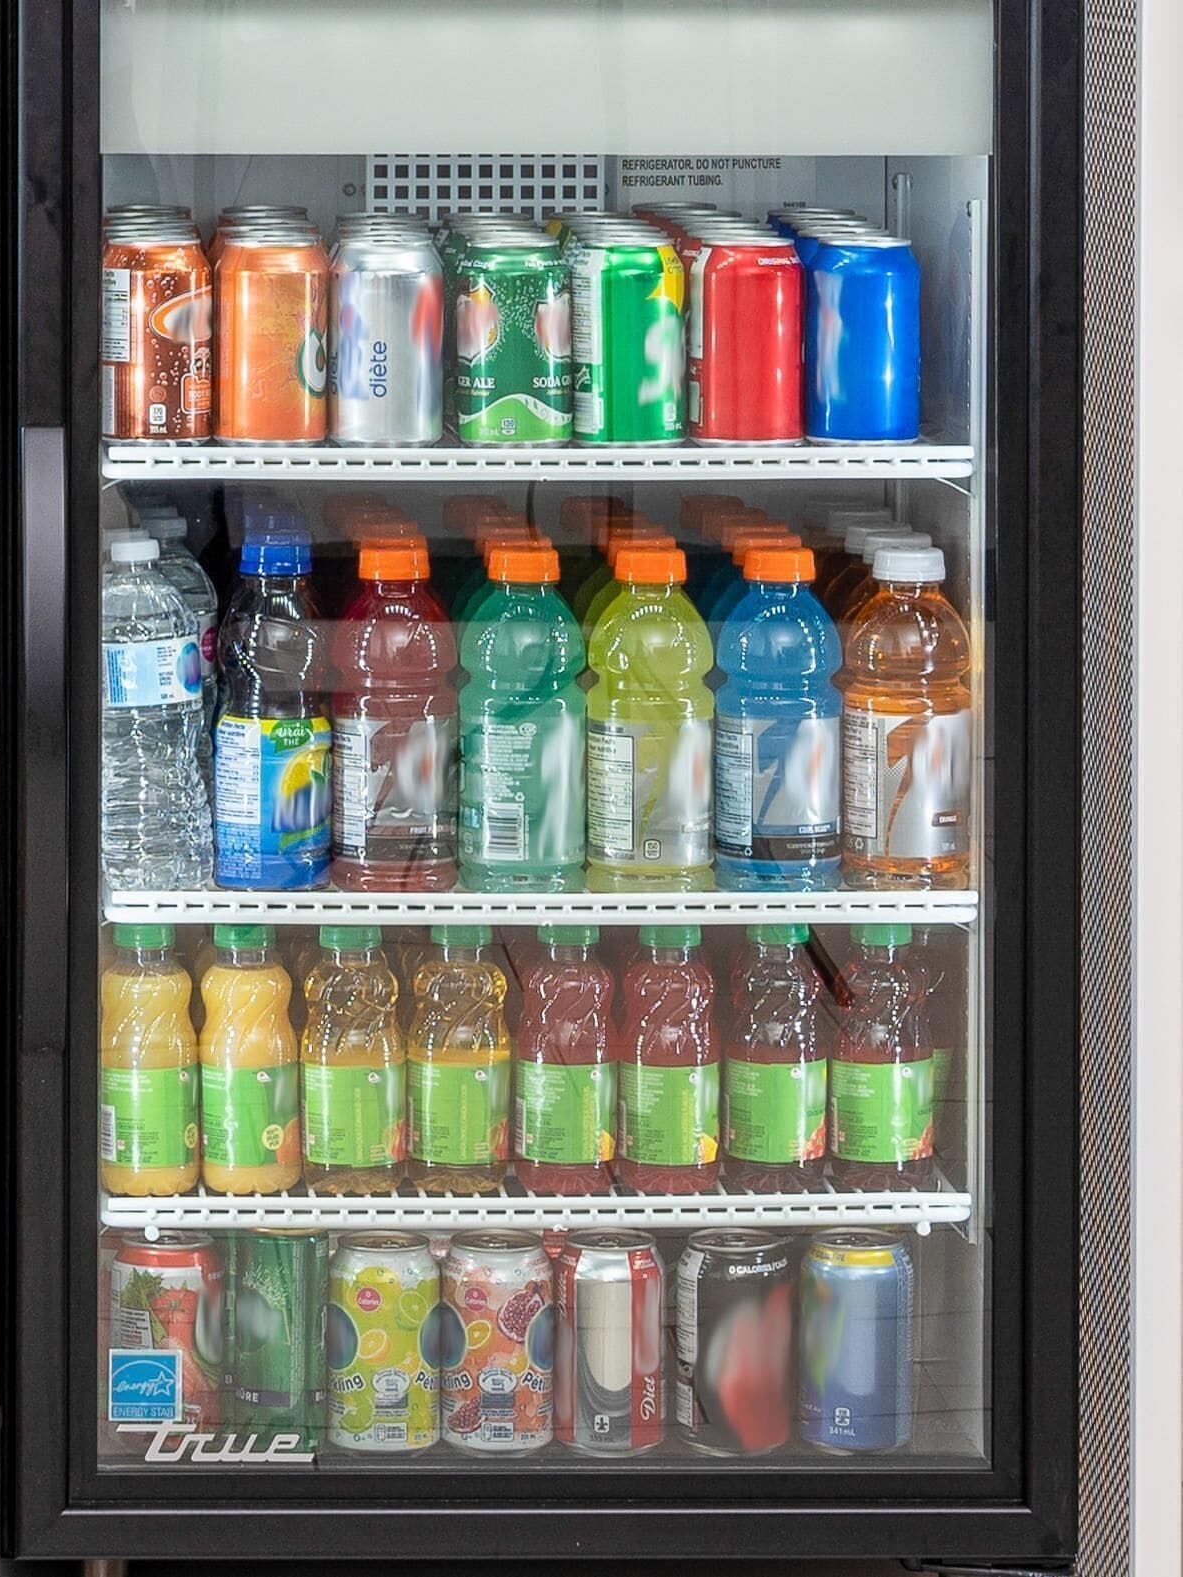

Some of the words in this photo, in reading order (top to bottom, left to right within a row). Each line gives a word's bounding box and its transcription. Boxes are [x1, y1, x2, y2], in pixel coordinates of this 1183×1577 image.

[695, 158, 709, 170] DO
[711, 158, 731, 170] NOT
[732, 158, 781, 170] PUNCTURE
[621, 175, 685, 187] REFRIGERANT
[687, 174, 723, 186] TUBING.
[369, 341, 387, 398] diète
[473, 377, 495, 388] ALE
[533, 376, 561, 388] SODA
[640, 1376, 655, 1421] Diet
[113, 1406, 149, 1417] ENERGY
[150, 1406, 174, 1417] STAR
